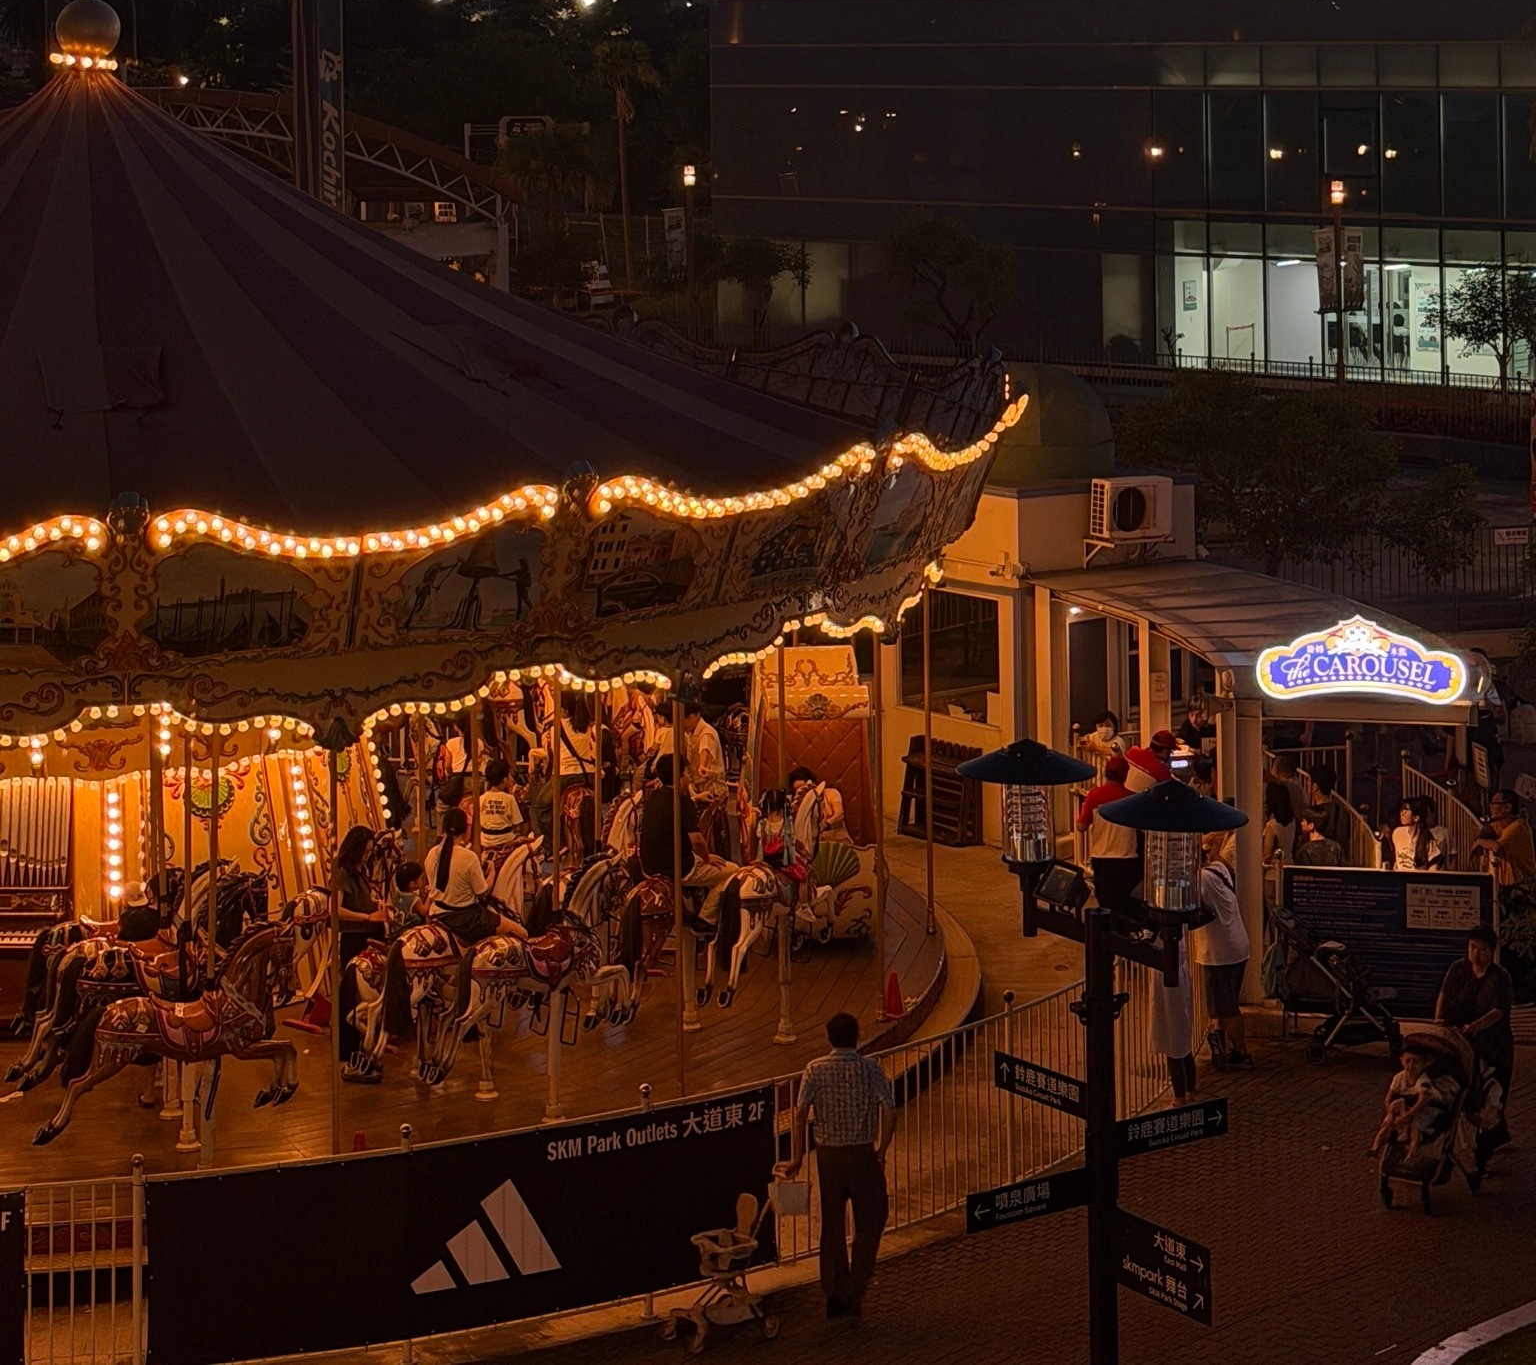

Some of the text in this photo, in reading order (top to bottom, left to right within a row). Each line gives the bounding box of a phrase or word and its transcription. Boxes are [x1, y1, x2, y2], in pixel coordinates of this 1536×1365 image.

[1281, 653, 1437, 685] the CAROUSEL
[1014, 1063, 1079, 1104] 鈴鹿賽道樂園
[547, 1100, 766, 1162] SKM Park Outlets 大道東 2F
[1127, 1108, 1204, 1142] 鈴鹿賽道樂園
[995, 1181, 1050, 1210] 噴泉廣場
[1153, 1230, 1187, 1262] 大道東
[1122, 1253, 1187, 1302] skmpark 舞台
